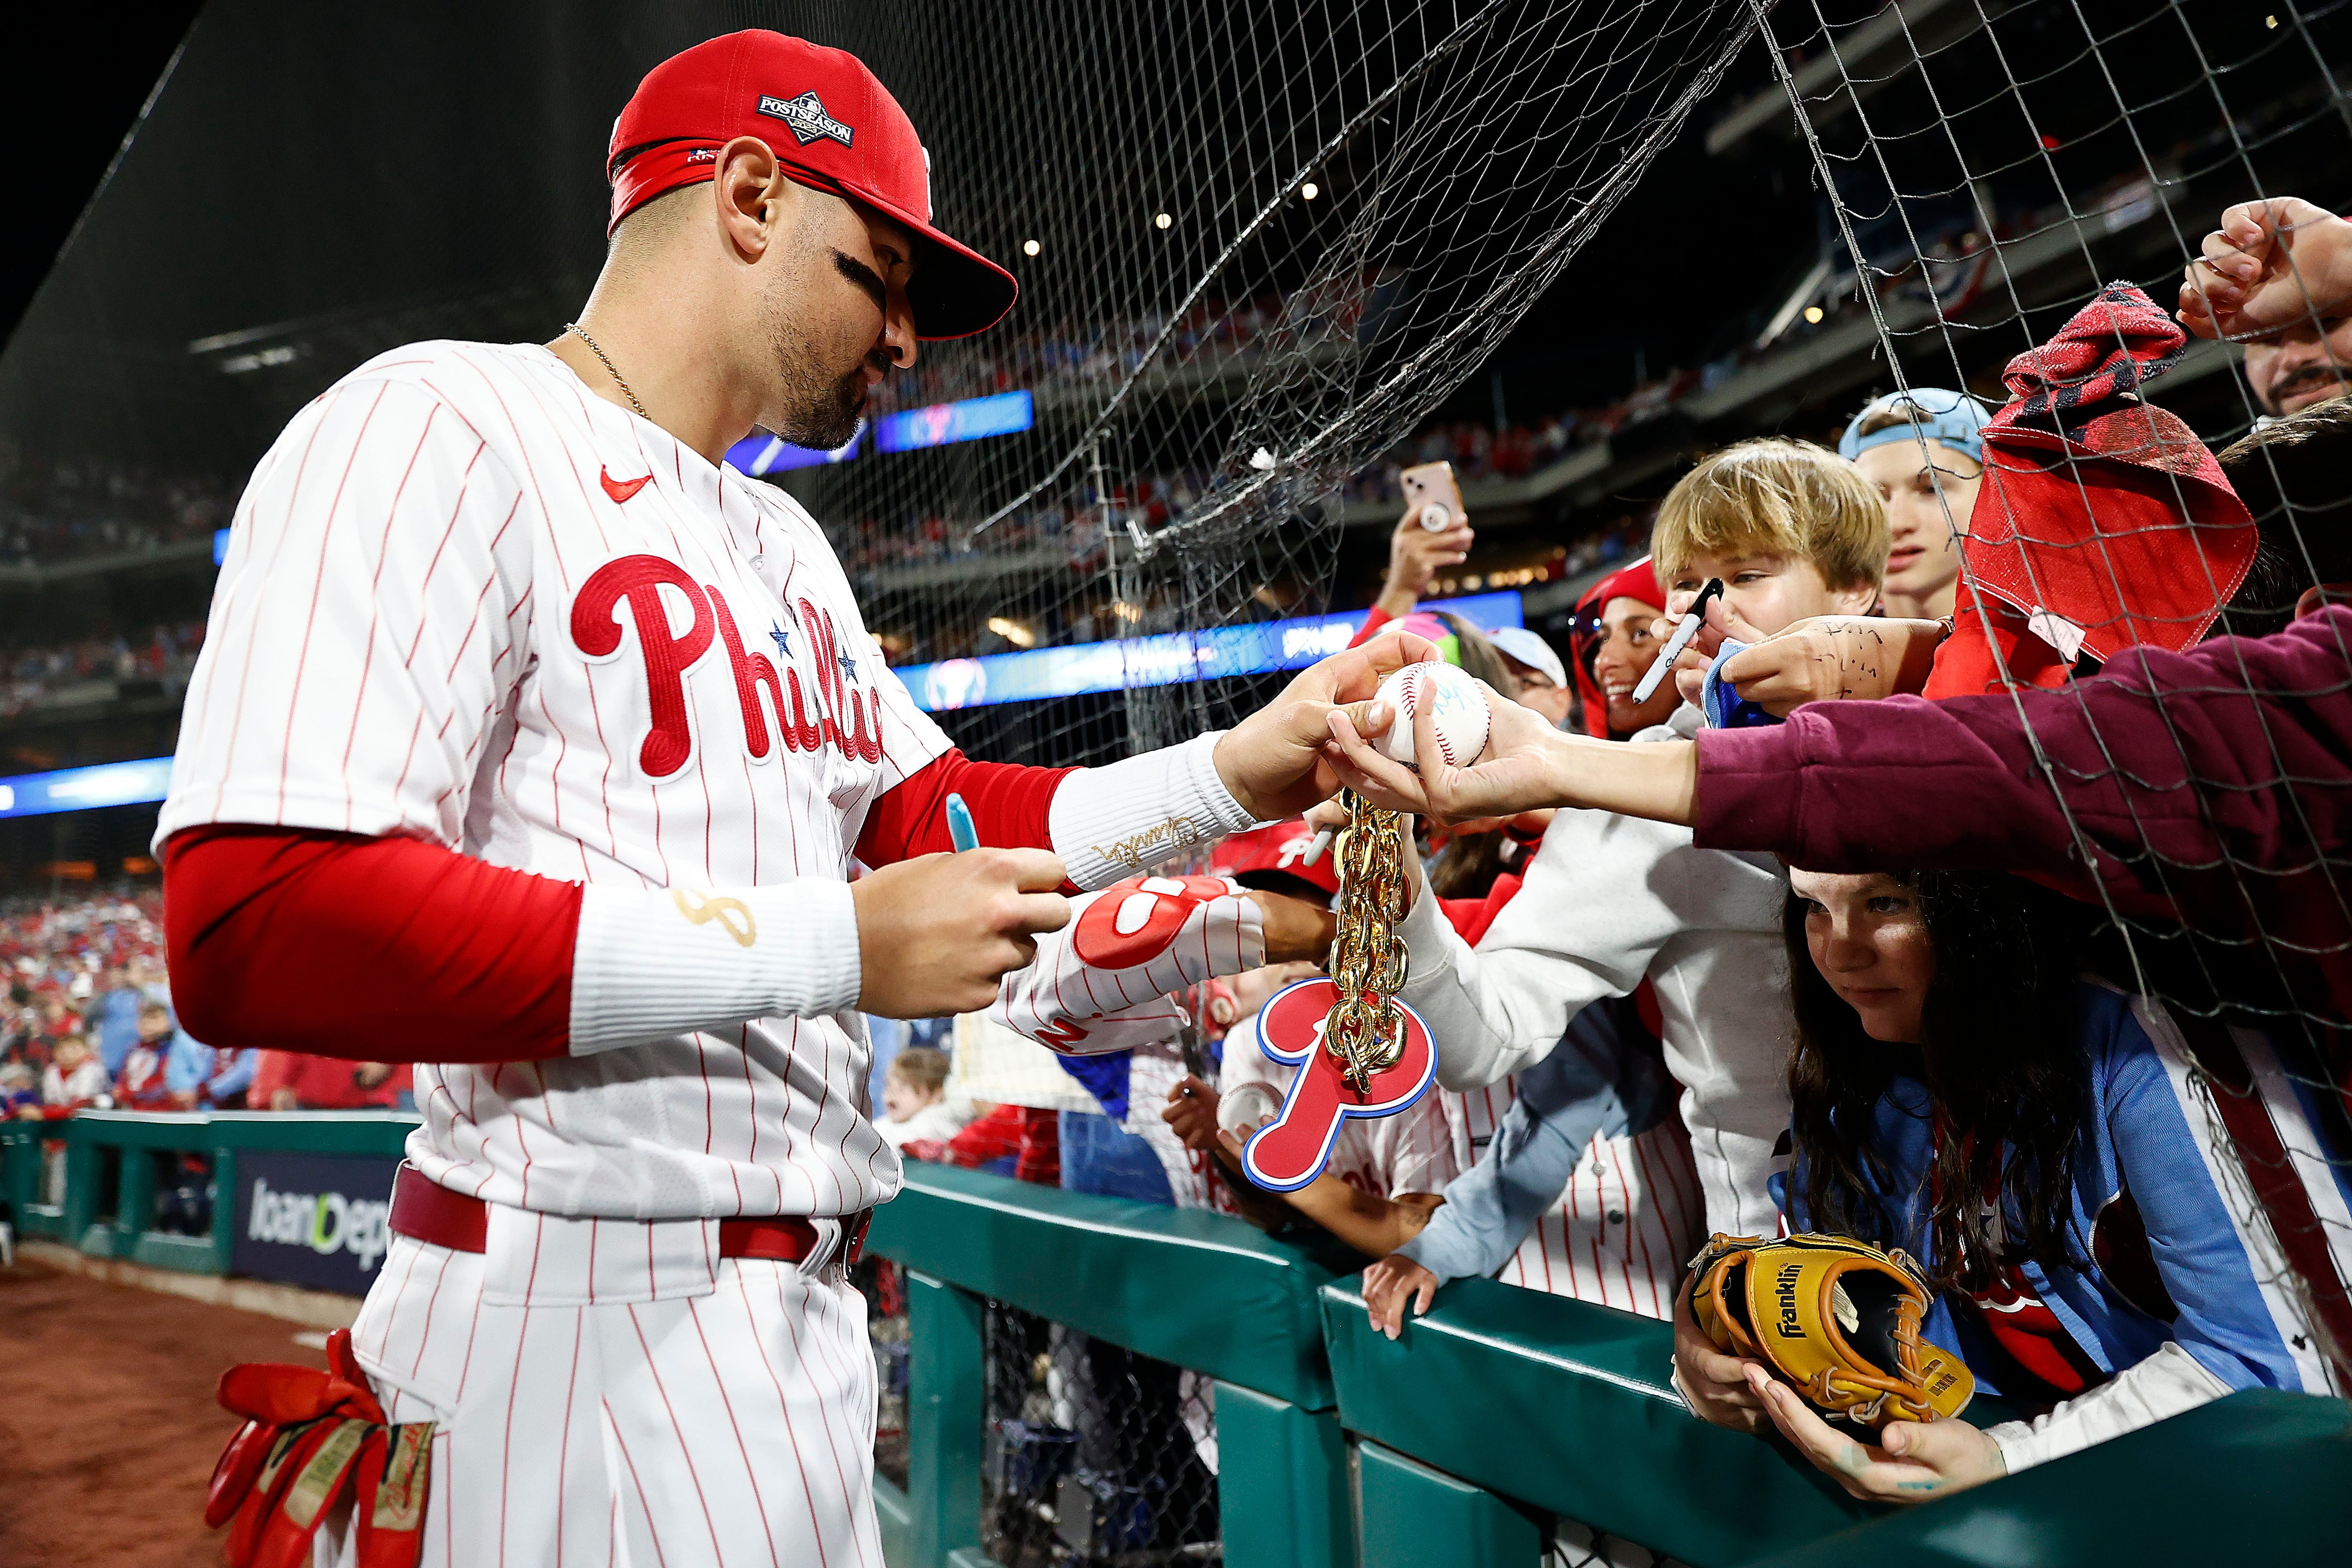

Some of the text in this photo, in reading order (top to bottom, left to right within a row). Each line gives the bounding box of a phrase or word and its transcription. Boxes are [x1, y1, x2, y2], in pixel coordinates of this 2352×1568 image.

[760, 99, 851, 141] POSTSEASON
[793, 120, 818, 134] 2023
[1775, 1263, 1807, 1338] Franklin
